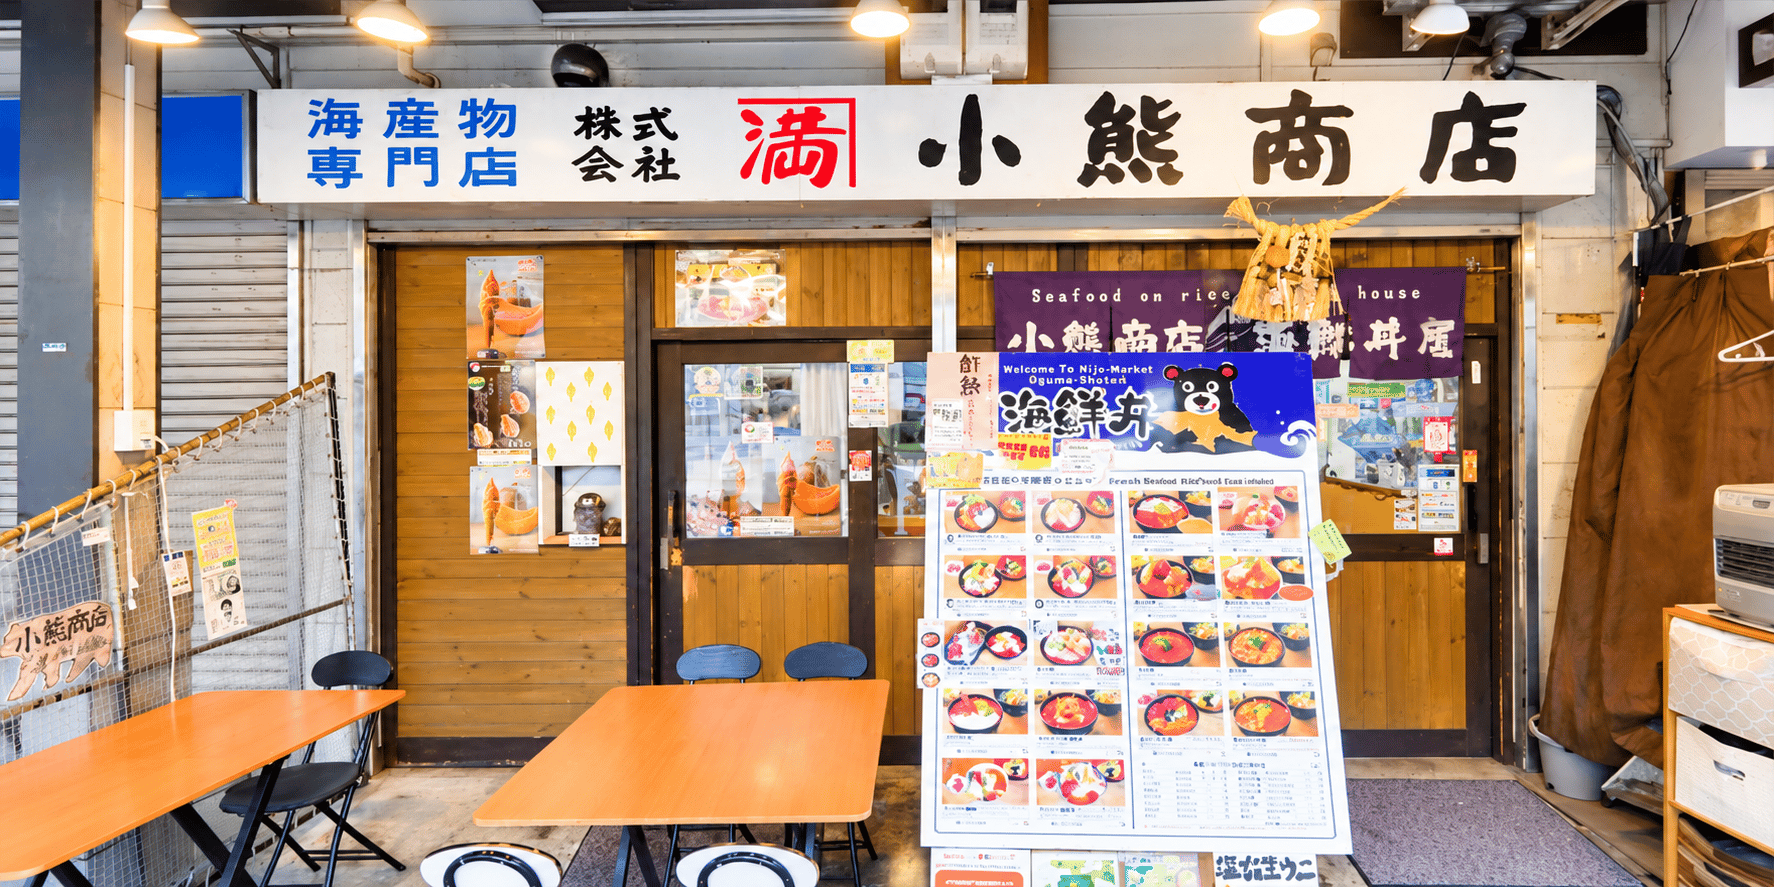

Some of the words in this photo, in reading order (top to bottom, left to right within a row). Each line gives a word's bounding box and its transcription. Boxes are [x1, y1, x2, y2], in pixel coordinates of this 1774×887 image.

[308, 98, 517, 140] 海産物
[574, 106, 679, 142] 株式
[739, 98, 857, 188] 満
[919, 91, 1527, 187] 小熊商店
[307, 145, 517, 189] 専門店
[571, 146, 681, 183] 会社
[1031, 288, 1122, 303] Seafood
[1140, 292, 1162, 302] on
[1181, 289, 1231, 302] rice
[1357, 285, 1421, 300] house
[1003, 364, 1055, 374] Welcome
[1058, 364, 1075, 374] To
[1079, 363, 1153, 377] Nijo-Market
[1028, 374, 1128, 386] Oguma-Shoten
[999, 387, 1154, 440] 海鮮丼
